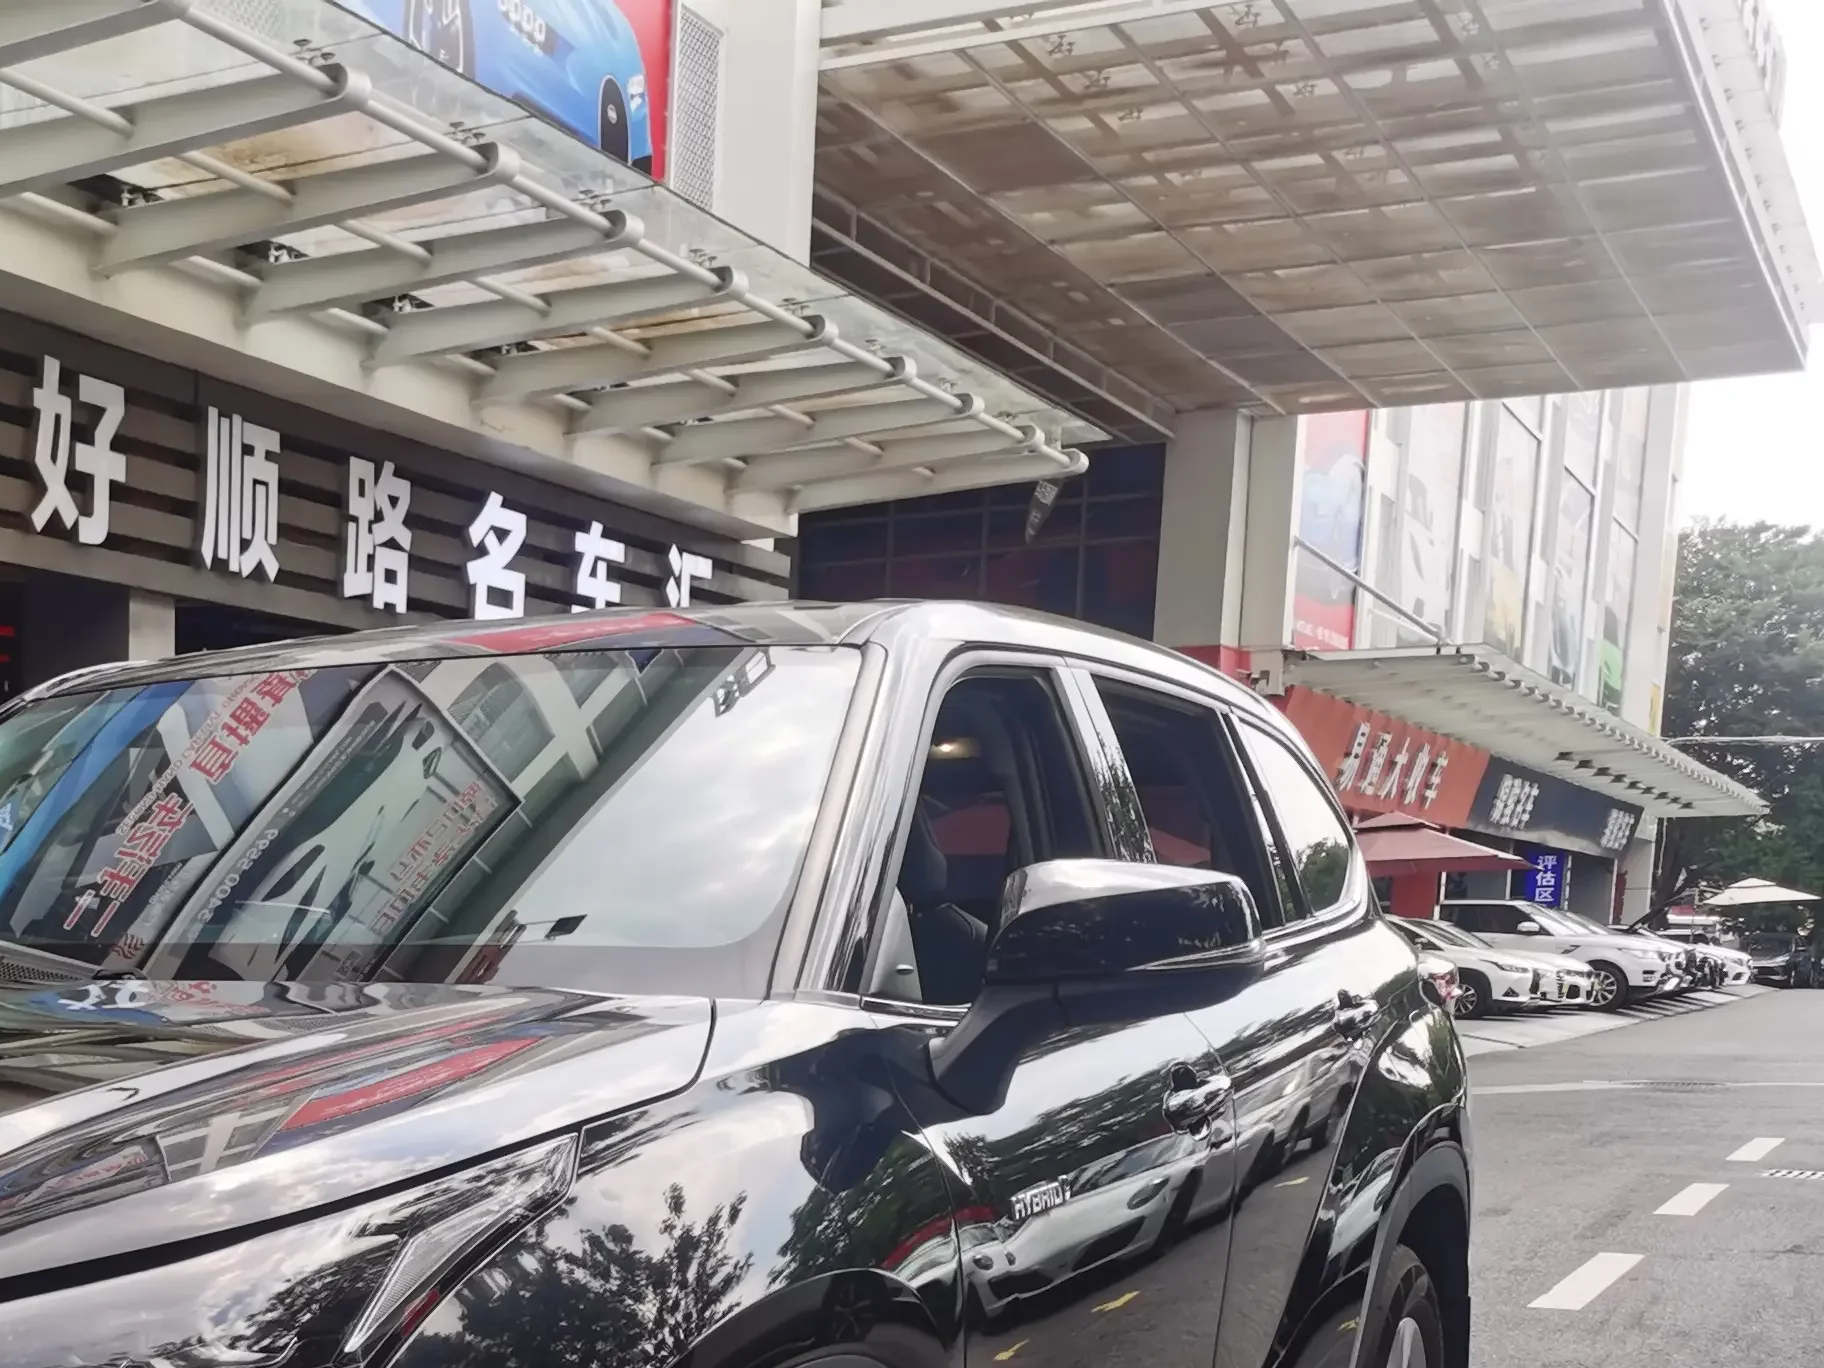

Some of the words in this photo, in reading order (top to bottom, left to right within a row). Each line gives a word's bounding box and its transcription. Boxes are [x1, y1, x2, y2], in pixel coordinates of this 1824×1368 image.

[1534, 855, 1558, 902] 评估区
[1010, 1179, 1066, 1221] HYBRID
